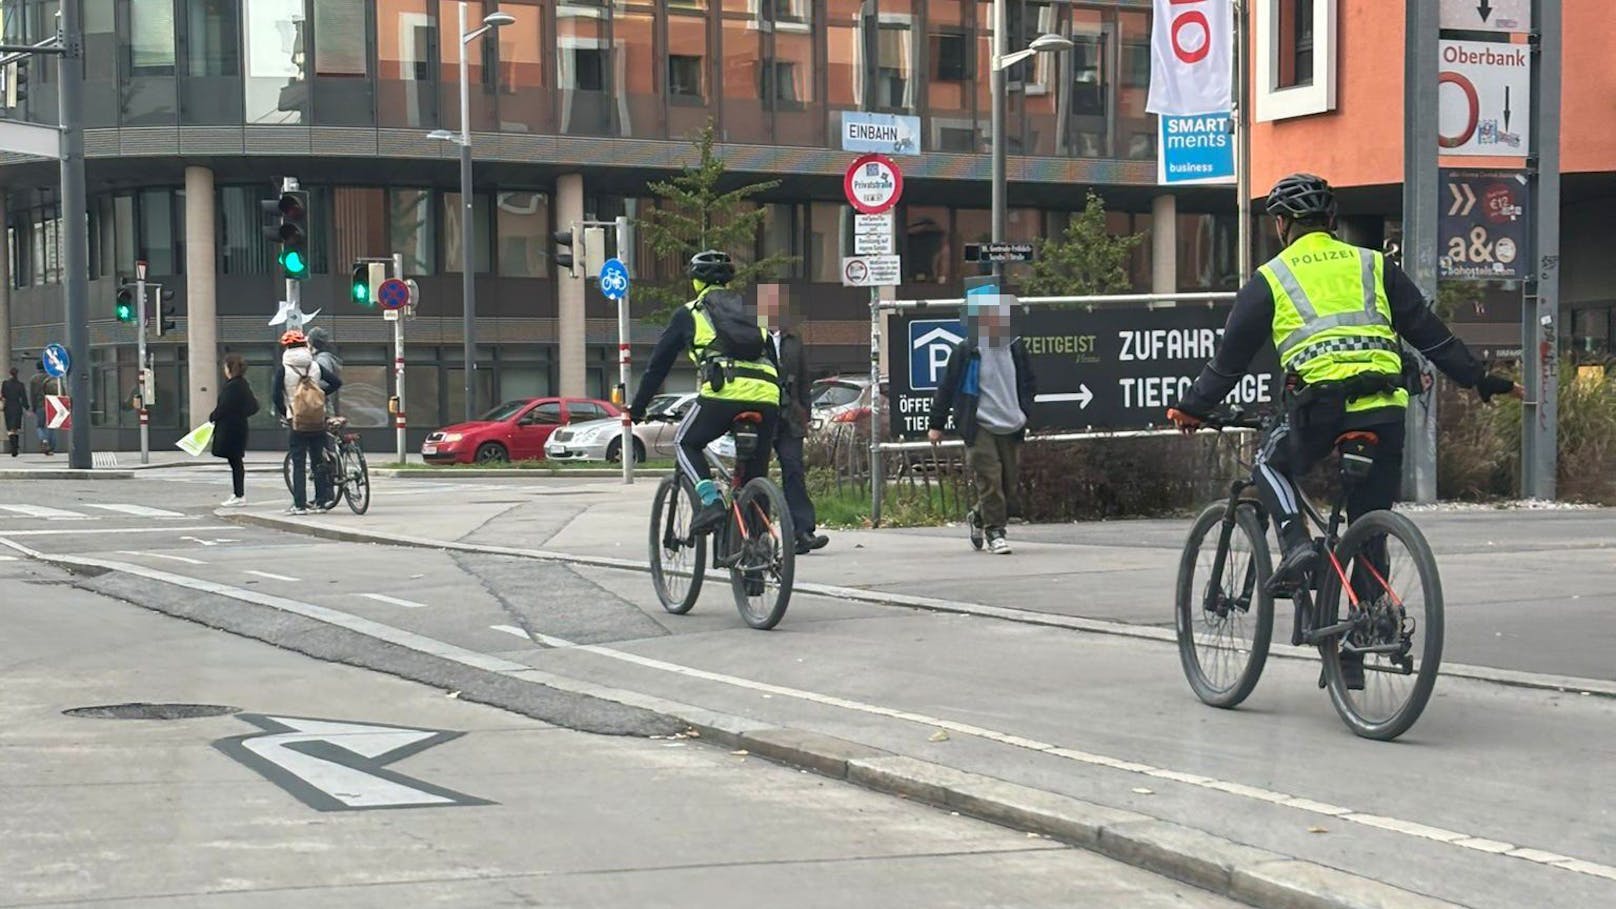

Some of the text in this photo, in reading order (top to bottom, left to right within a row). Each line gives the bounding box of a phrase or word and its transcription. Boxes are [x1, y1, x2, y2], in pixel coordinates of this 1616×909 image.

[1443, 45, 1526, 67] Oberbank
[849, 124, 898, 141] EINBAHN
[1168, 118, 1227, 133] SMART
[1168, 132, 1226, 148] ments
[1169, 162, 1213, 173] business
[1291, 250, 1355, 267] POLIZEI
[1022, 335, 1097, 354] ZEITGEIST
[1118, 373, 1272, 408] TIEFAGE
